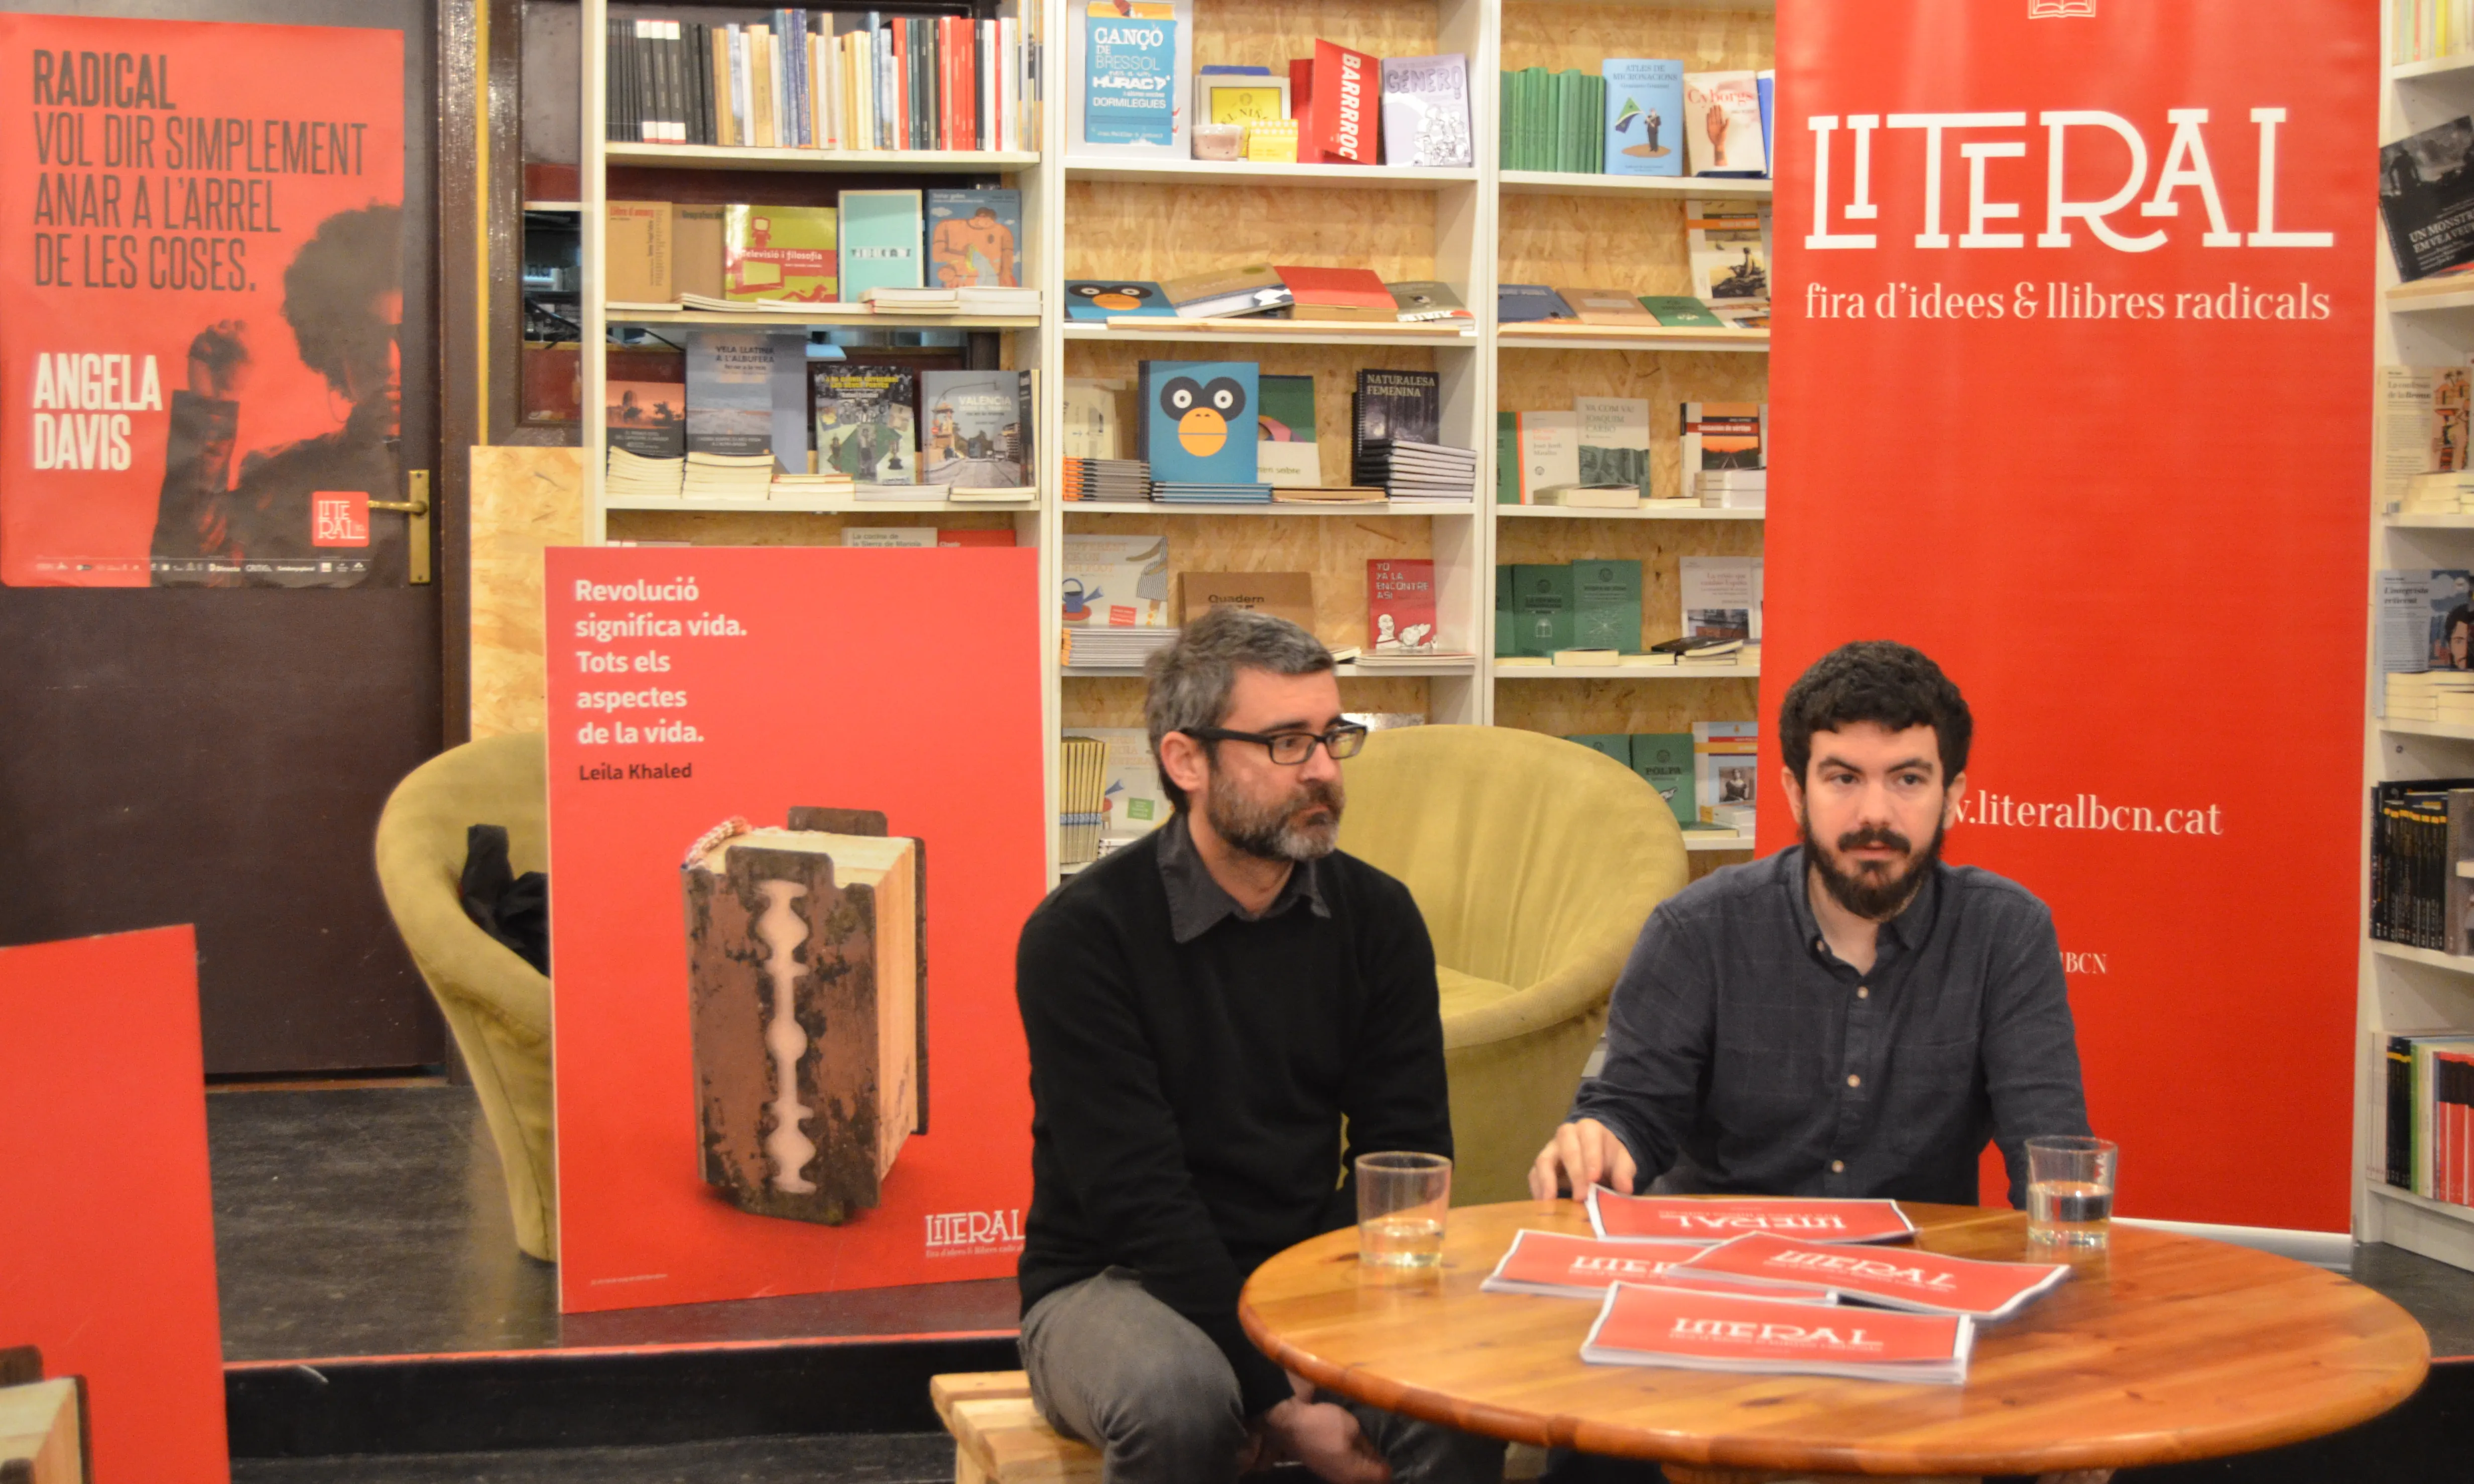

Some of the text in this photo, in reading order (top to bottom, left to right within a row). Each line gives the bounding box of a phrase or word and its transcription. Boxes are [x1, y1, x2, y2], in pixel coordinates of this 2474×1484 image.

[1096, 45, 1111, 54] DE
[1095, 55, 1160, 71] BRESSOL
[34, 49, 176, 109] RADICAL
[1093, 97, 1166, 109] DORMILEGUES
[1688, 89, 1754, 107] Cyborgs
[34, 111, 367, 176] VOL DIR SIMPLEMENT
[1805, 108, 2333, 252] LITERAL
[34, 173, 281, 232] ANAR A L'ARREL
[2409, 228, 2427, 242] UN
[35, 233, 256, 292] DE LES COSES.
[787, 251, 822, 261] filosofia
[1805, 281, 2330, 320] fira d'idees & llibres radicals
[34, 352, 163, 411] ANGELA
[1367, 375, 1435, 386] NATURALESA
[1367, 386, 1421, 397] FEMENINA
[34, 413, 131, 471] DAVIS
[318, 501, 350, 520] LITE
[318, 520, 366, 540] RAL
[1376, 563, 1390, 571] YO
[575, 576, 699, 601] Revolució
[1208, 594, 1265, 603] Quadern
[575, 613, 747, 642] significa vida.
[576, 649, 670, 672] Tots els
[577, 688, 687, 713] aspectes
[578, 719, 704, 744] de la vida.
[629, 762, 692, 779] Khaled
[925, 1209, 1026, 1246] LITERAL
[1772, 1250, 1957, 1289] LITERAL
[1673, 1318, 1884, 1346] LITERAL
